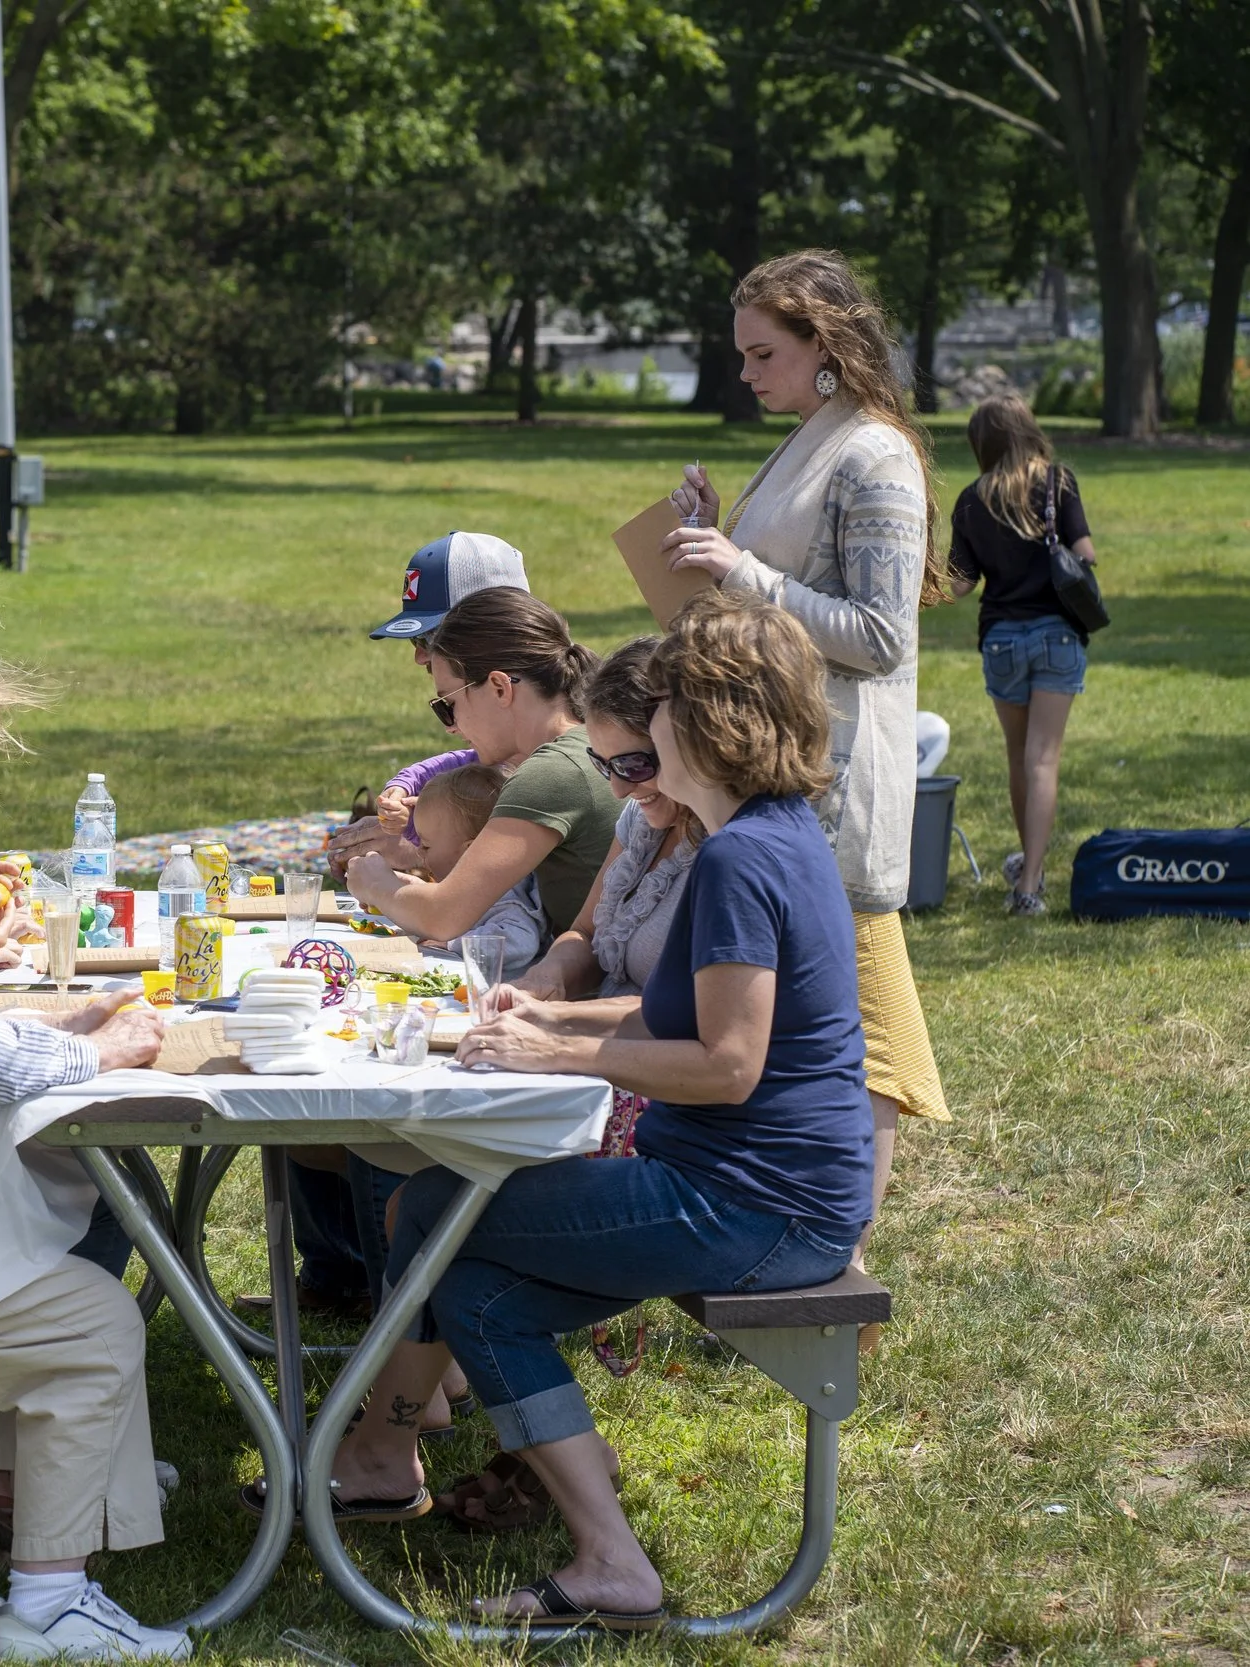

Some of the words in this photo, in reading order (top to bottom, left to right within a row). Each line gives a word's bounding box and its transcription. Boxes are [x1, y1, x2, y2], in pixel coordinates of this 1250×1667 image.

[1117, 854, 1226, 883] GRACO
[192, 931, 215, 961] La
[176, 952, 219, 983] Croix
